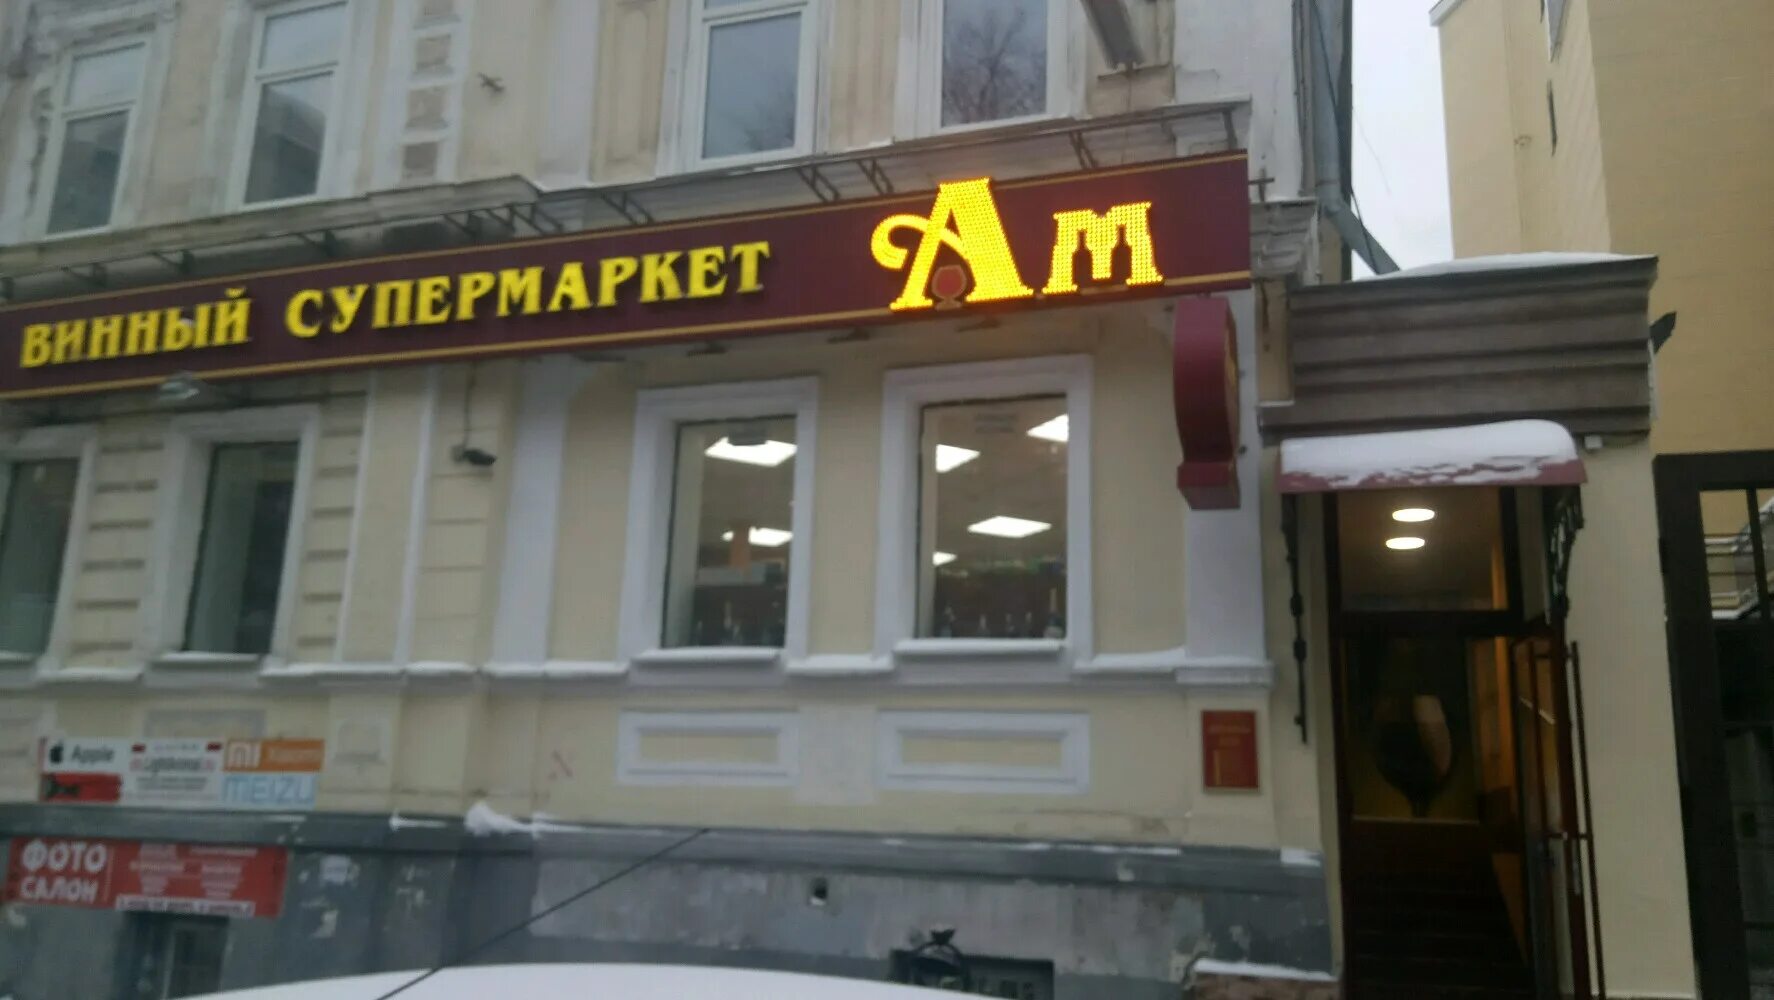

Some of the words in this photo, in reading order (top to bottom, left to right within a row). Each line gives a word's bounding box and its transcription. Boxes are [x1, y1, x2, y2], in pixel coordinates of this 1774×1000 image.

[19, 287, 252, 368] ВИННЫЙ
[284, 241, 771, 338] СУПЕРМАРКЕТ
[22, 838, 108, 873] ФОТО
[19, 875, 99, 905] САЛОН
